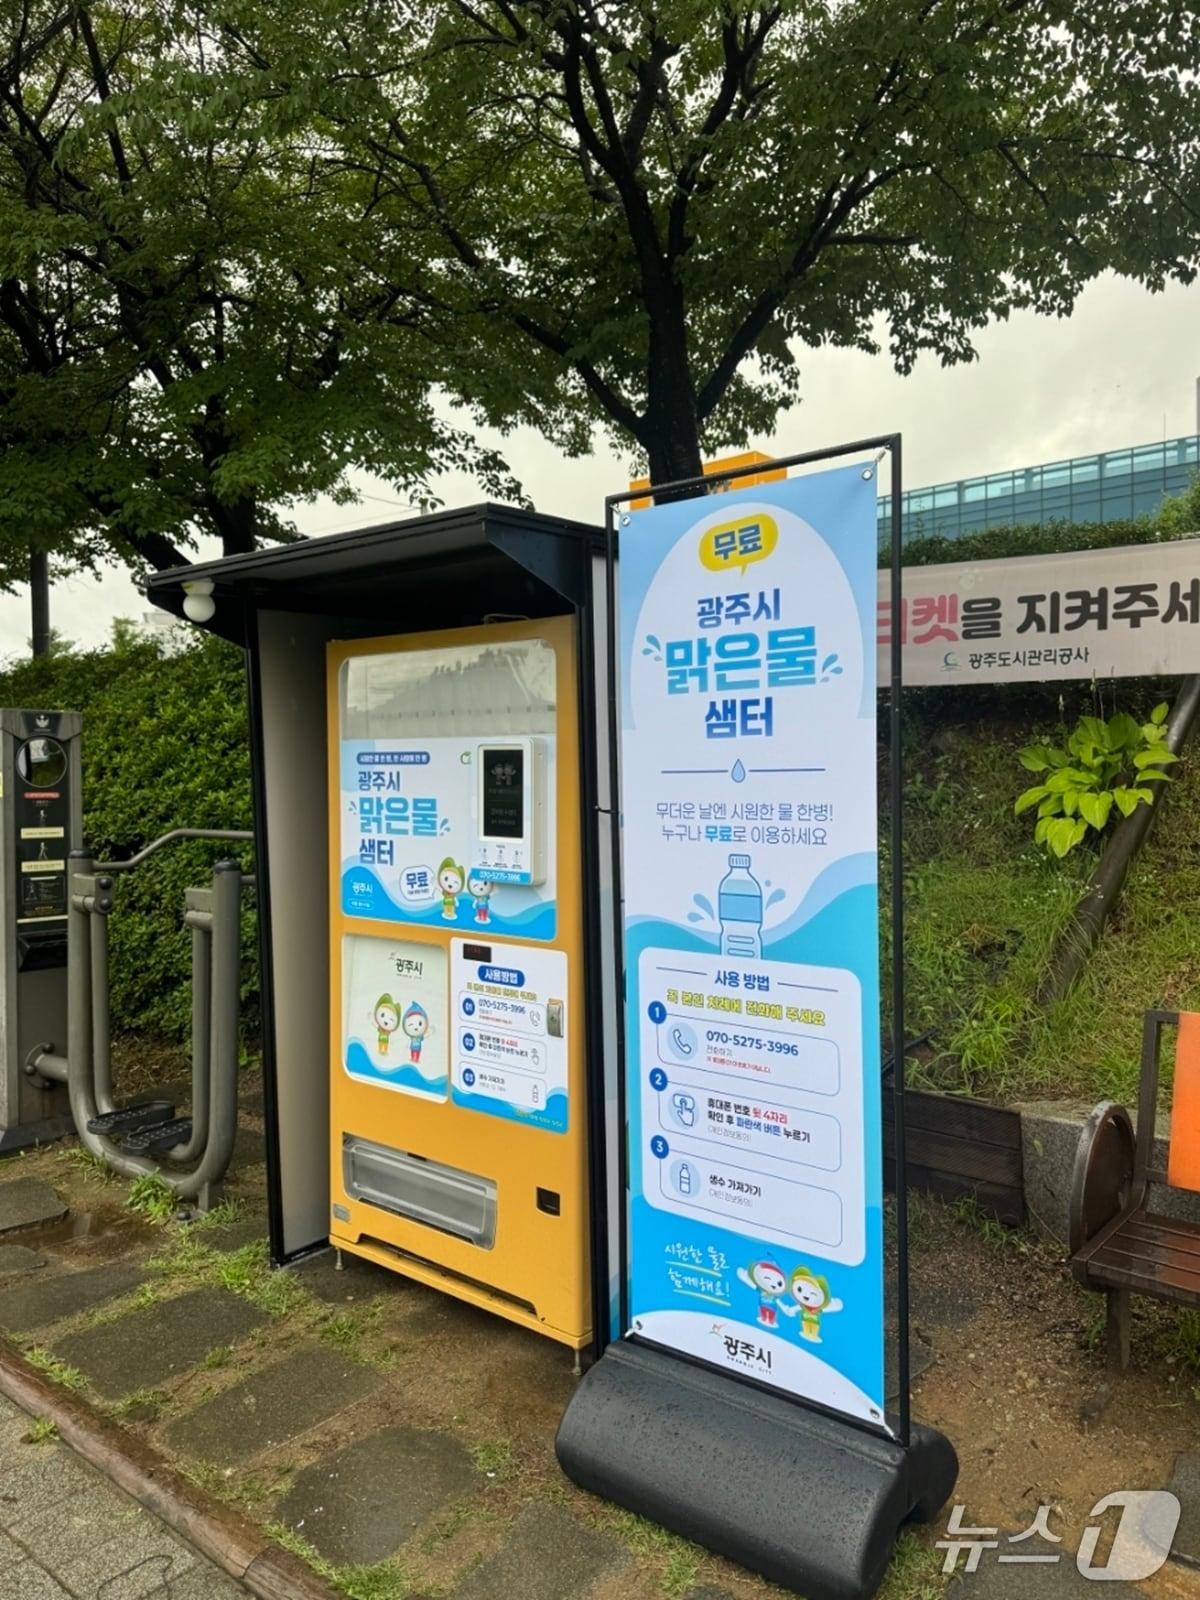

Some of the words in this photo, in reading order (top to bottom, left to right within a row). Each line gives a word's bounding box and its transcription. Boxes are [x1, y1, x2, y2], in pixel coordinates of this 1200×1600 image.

[714, 524, 762, 560] 무료
[697, 588, 780, 629] 광주시
[665, 626, 817, 695] 맑은물
[969, 647, 1089, 670] 광주도시관리공사
[705, 697, 773, 739] 샘터
[358, 771, 400, 792] 광주시
[359, 797, 438, 837] 맑은물
[656, 802, 695, 820] 무더운
[699, 803, 726, 820] 날엔
[730, 802, 774, 821] 시원한
[778, 803, 793, 821] 물
[797, 803, 833, 822] 한병!
[662, 825, 701, 842] 누구나
[705, 825, 747, 843] 무료로
[751, 826, 827, 845] 이용하세요
[360, 838, 394, 866] 샘터
[406, 871, 429, 888] 무료
[396, 958, 423, 976] 광주시
[714, 970, 740, 988] 사용
[743, 973, 770, 991] 방법
[655, 1007, 660, 1018] 1
[786, 1007, 825, 1026] 주세요
[706, 1030, 799, 1056] 070-5275-3996
[655, 1073, 662, 1085] 2
[734, 1104, 751, 1116] 번호
[763, 1110, 788, 1124] 4자리
[783, 1127, 811, 1143] 누르기
[656, 1141, 663, 1152] 3
[709, 1174, 726, 1187] 생수
[665, 1243, 702, 1264] 시원한
[723, 1335, 772, 1369] 광주시
